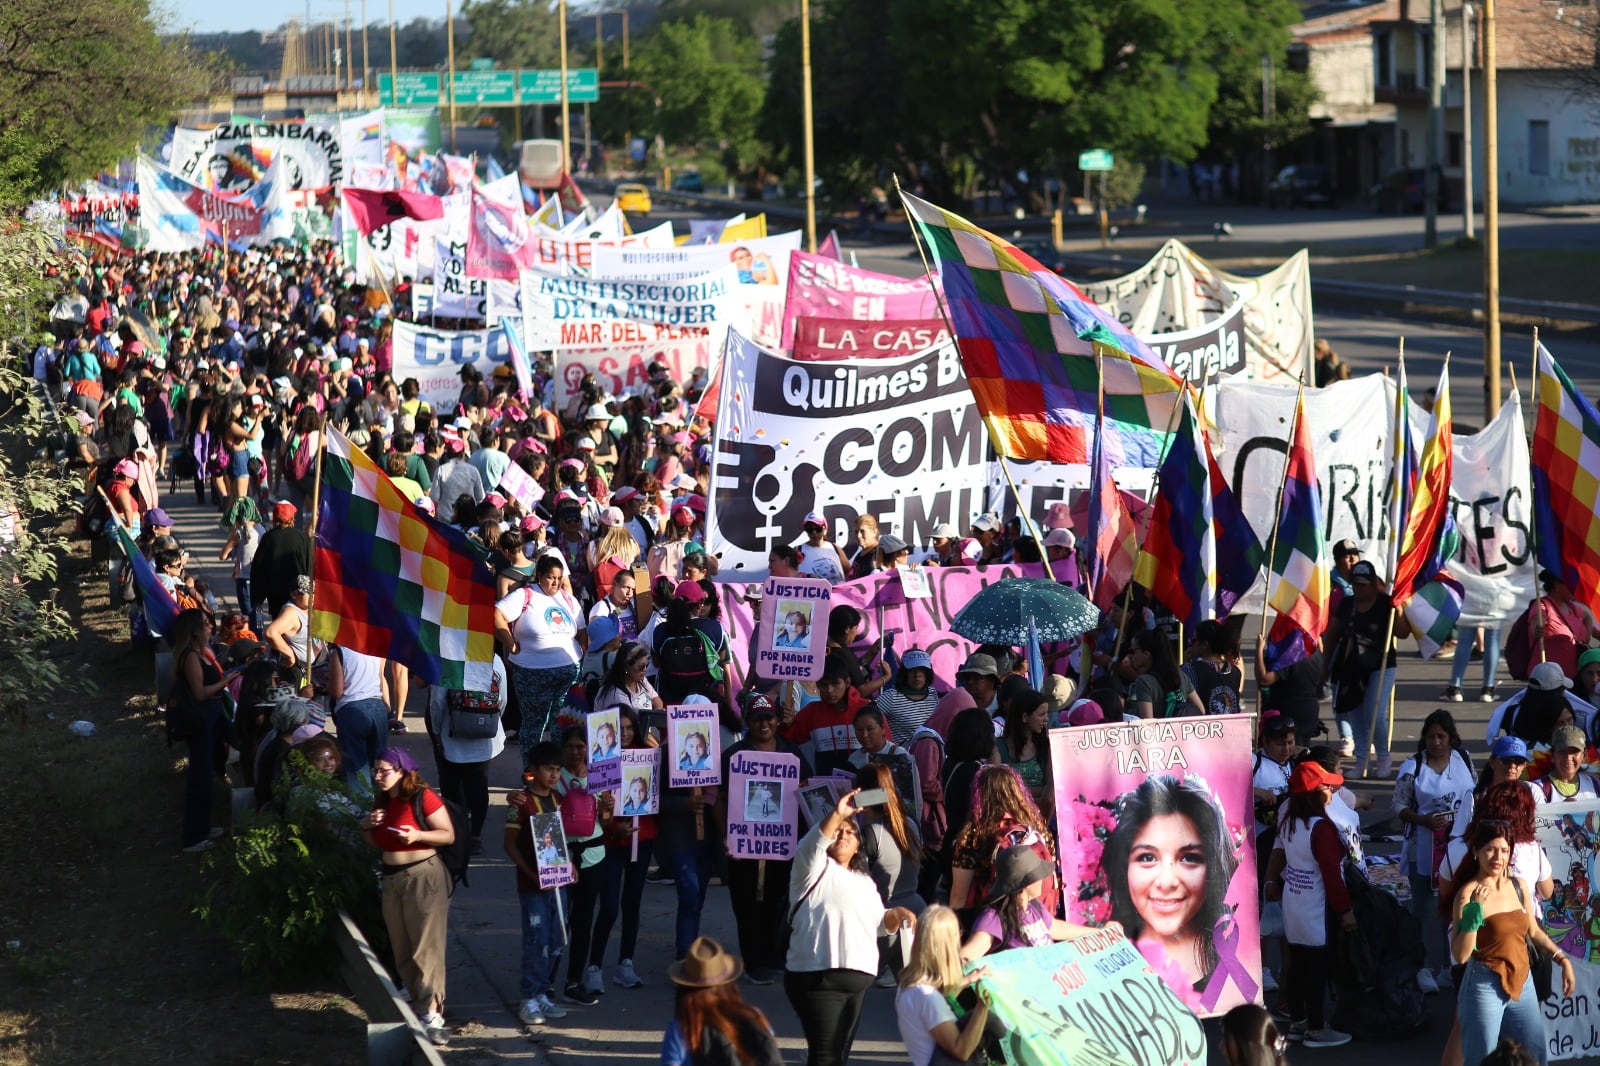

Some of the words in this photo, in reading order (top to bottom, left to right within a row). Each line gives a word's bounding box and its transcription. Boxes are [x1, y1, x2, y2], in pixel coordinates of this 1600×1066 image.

[540, 276, 728, 302] MULTISECTORIAL
[553, 296, 585, 319] DE
[591, 302, 619, 320] LA
[625, 303, 716, 325] MUJER
[560, 322, 602, 345] MAR
[611, 322, 648, 342] DEL
[655, 321, 710, 341] PLATA
[816, 327, 858, 351] LA
[872, 328, 951, 351] CASA
[418, 377, 459, 393] ujeres
[781, 360, 928, 410] Quilmes
[765, 579, 830, 600] JUSTICIA
[760, 651, 779, 661] POR
[782, 653, 814, 664] NADIR
[771, 662, 811, 677] FLORES
[670, 706, 714, 720] JUSTICIA
[1078, 721, 1177, 750] JUSTICIA
[1181, 720, 1224, 741] POR
[731, 754, 798, 779] JUSTICIA
[1117, 745, 1188, 775] IARA
[729, 823, 749, 835] POR
[753, 823, 792, 837] NADIR
[737, 838, 790, 855] FLORES
[1069, 926, 1124, 957] TUCUMAN
[1052, 959, 1088, 995] JUJUY
[1544, 991, 1589, 1020] San
[1549, 1030, 1574, 1056] de
